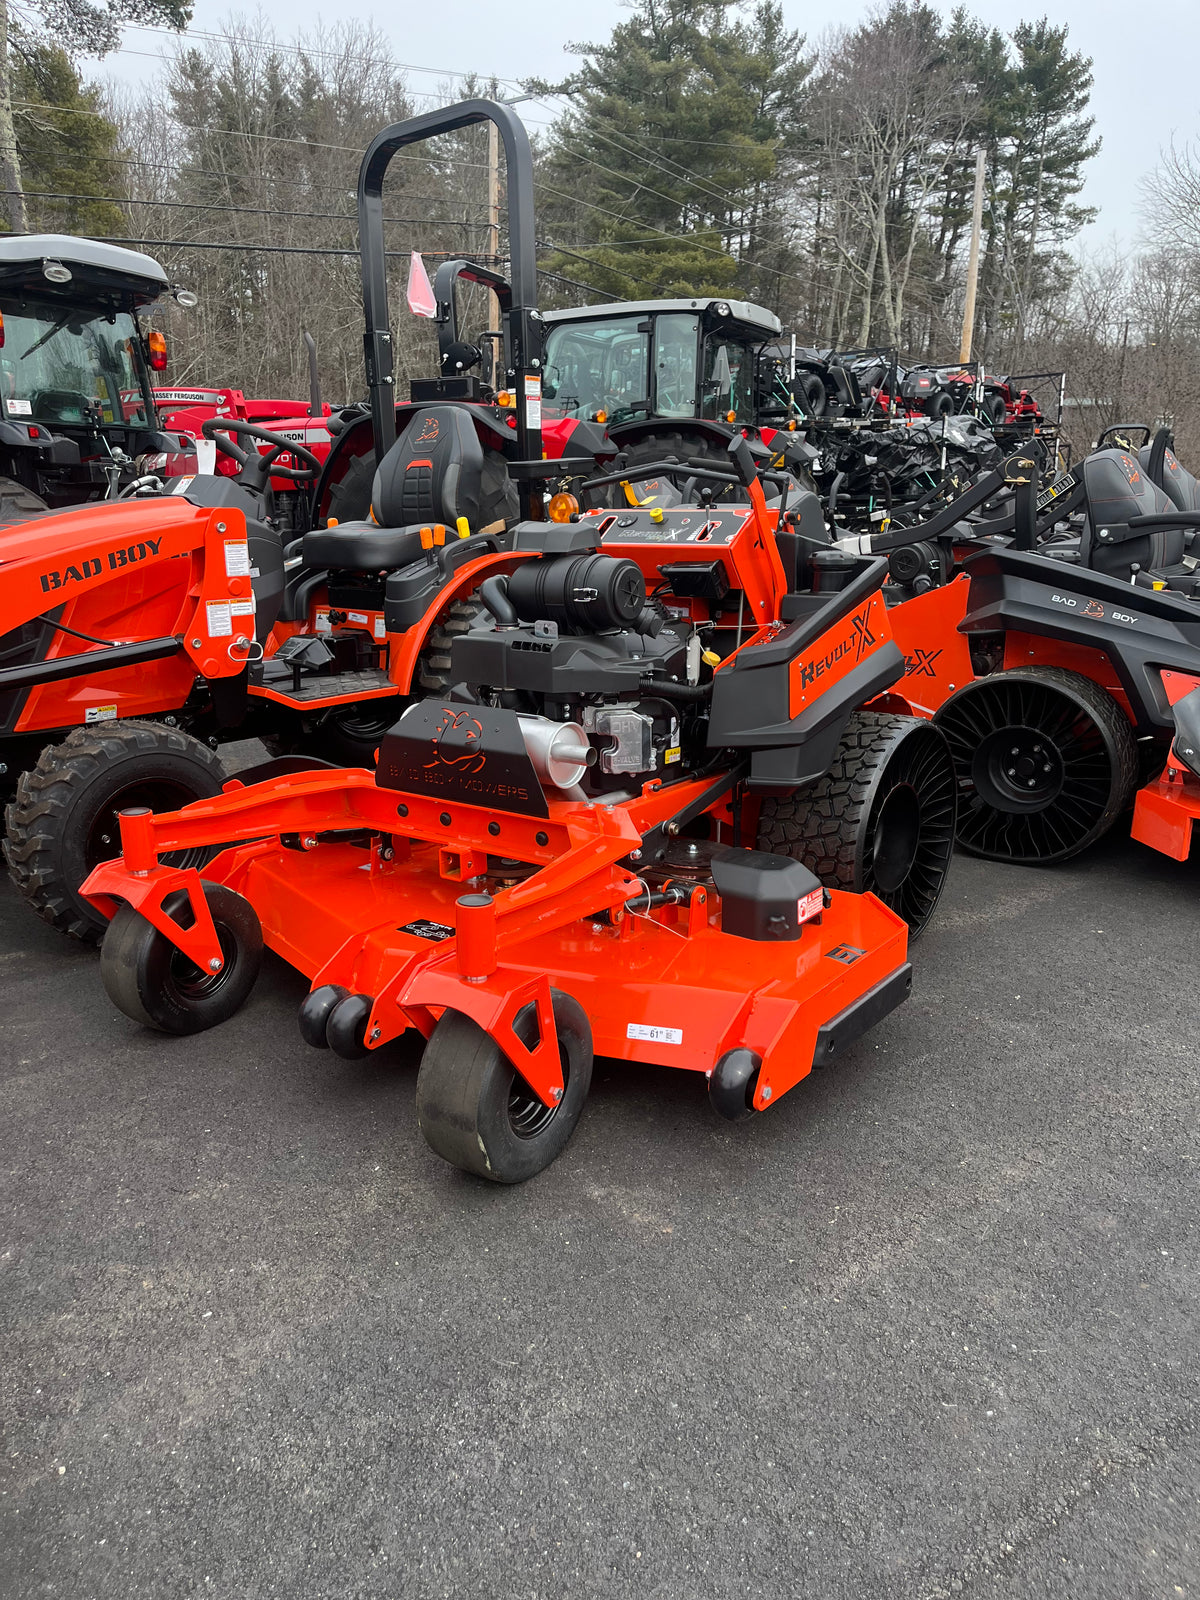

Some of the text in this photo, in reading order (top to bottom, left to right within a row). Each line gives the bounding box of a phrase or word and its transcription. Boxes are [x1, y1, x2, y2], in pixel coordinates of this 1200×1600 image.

[174, 392, 204, 400] FERGUSON
[40, 536, 163, 593] BAD BOY
[1051, 594, 1138, 624] BAD BOY
